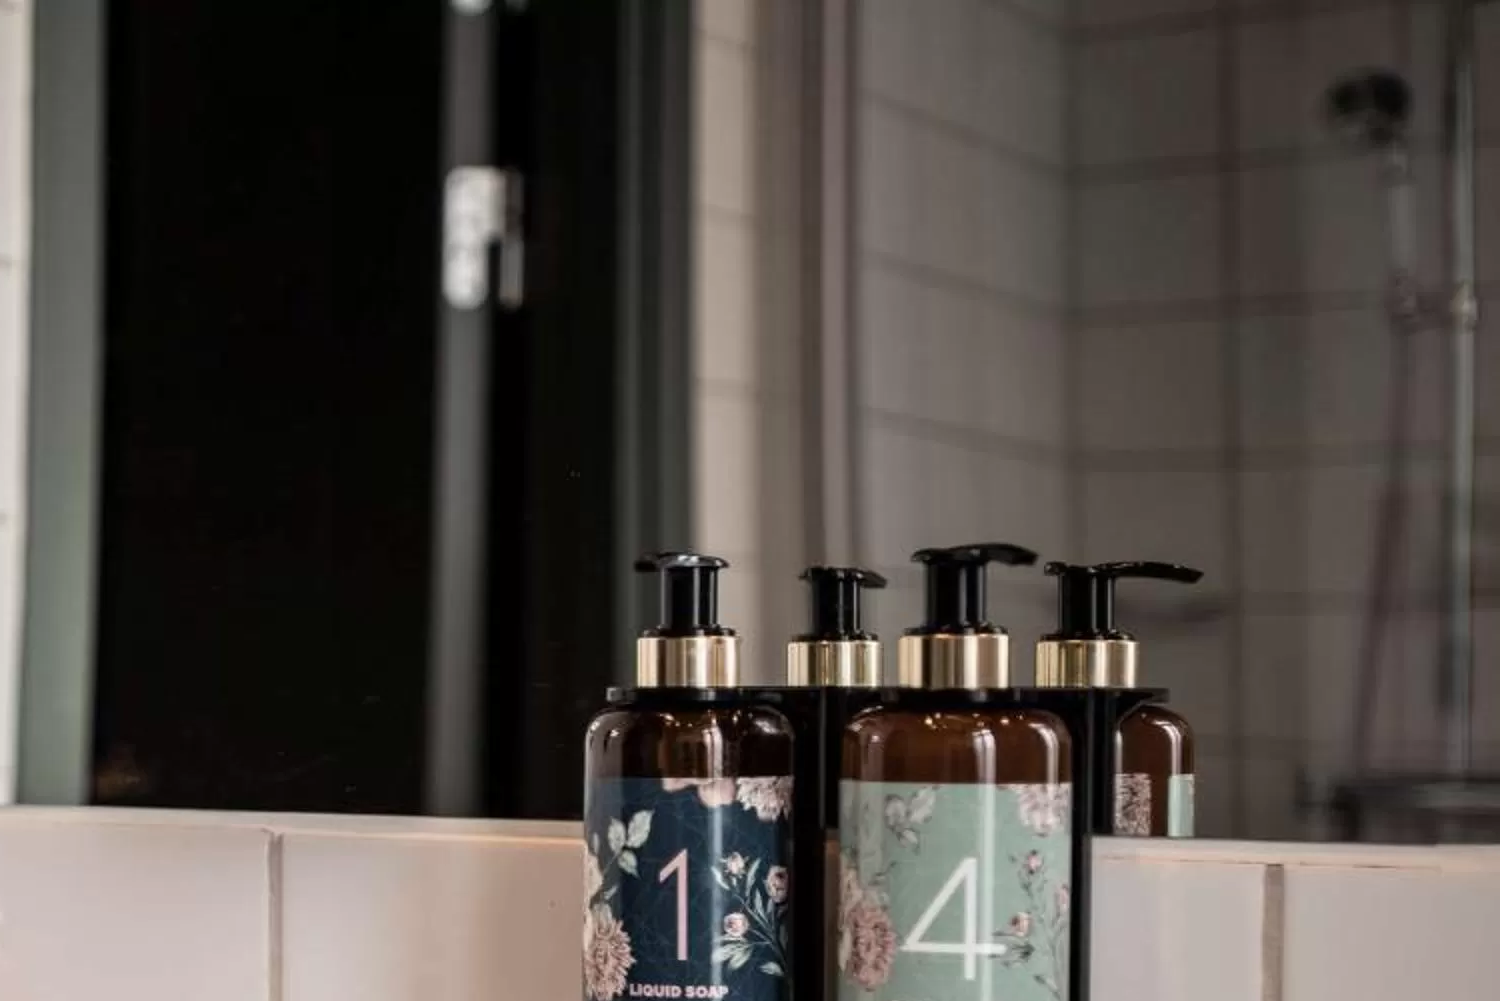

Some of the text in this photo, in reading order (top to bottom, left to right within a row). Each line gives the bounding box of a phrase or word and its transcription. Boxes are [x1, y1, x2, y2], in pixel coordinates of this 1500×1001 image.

[659, 848, 688, 961] 1
[900, 857, 1006, 981] 4
[629, 983, 729, 999] LIQUID SOAP
